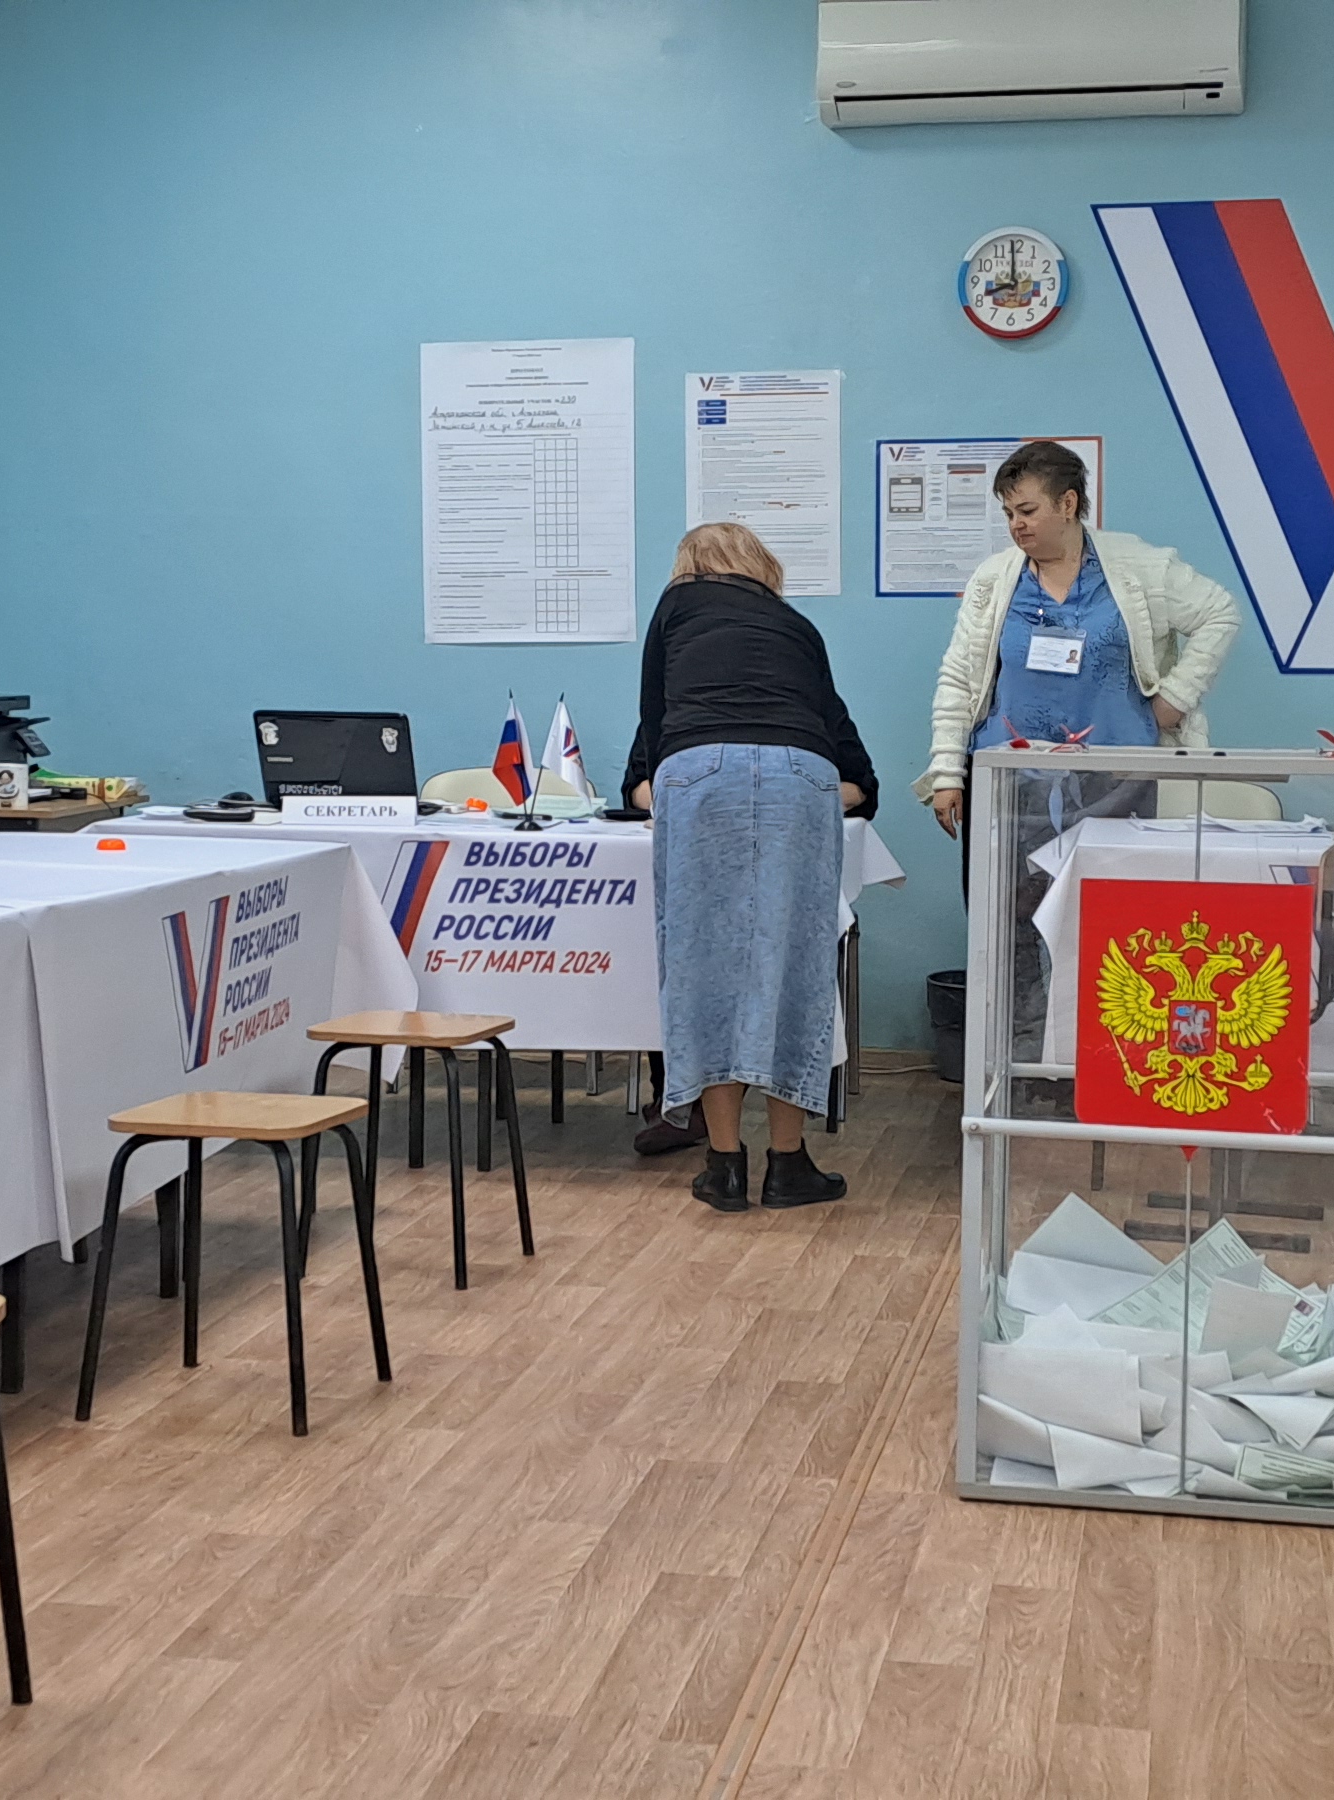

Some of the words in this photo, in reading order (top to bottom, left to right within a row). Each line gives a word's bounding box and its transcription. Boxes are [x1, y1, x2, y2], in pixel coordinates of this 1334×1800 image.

[994, 245, 1005, 258] 11
[1030, 245, 1037, 259] 1
[978, 259, 992, 272] 10
[1042, 260, 1051, 274] 2
[971, 275, 980, 289] 9
[1047, 277, 1055, 291] 3
[975, 294, 984, 308] 8
[1039, 295, 1047, 308] 4
[989, 307, 998, 321] 7
[1006, 312, 1015, 326] 6
[1025, 308, 1034, 322] 5
[304, 805, 398, 817] СЕКРЕТАРЬ
[464, 841, 598, 868] ВЫБОРЫ
[235, 875, 289, 924] ВЫБОРЫ
[448, 878, 637, 909] ПРЕЗИДЕНТА
[432, 915, 556, 941] РОССИИ
[228, 911, 301, 971] ПРЕЗИДЕНТА
[483, 951, 555, 974] МАРТА
[559, 951, 612, 974] 2024
[223, 965, 272, 1017] РОССИИ
